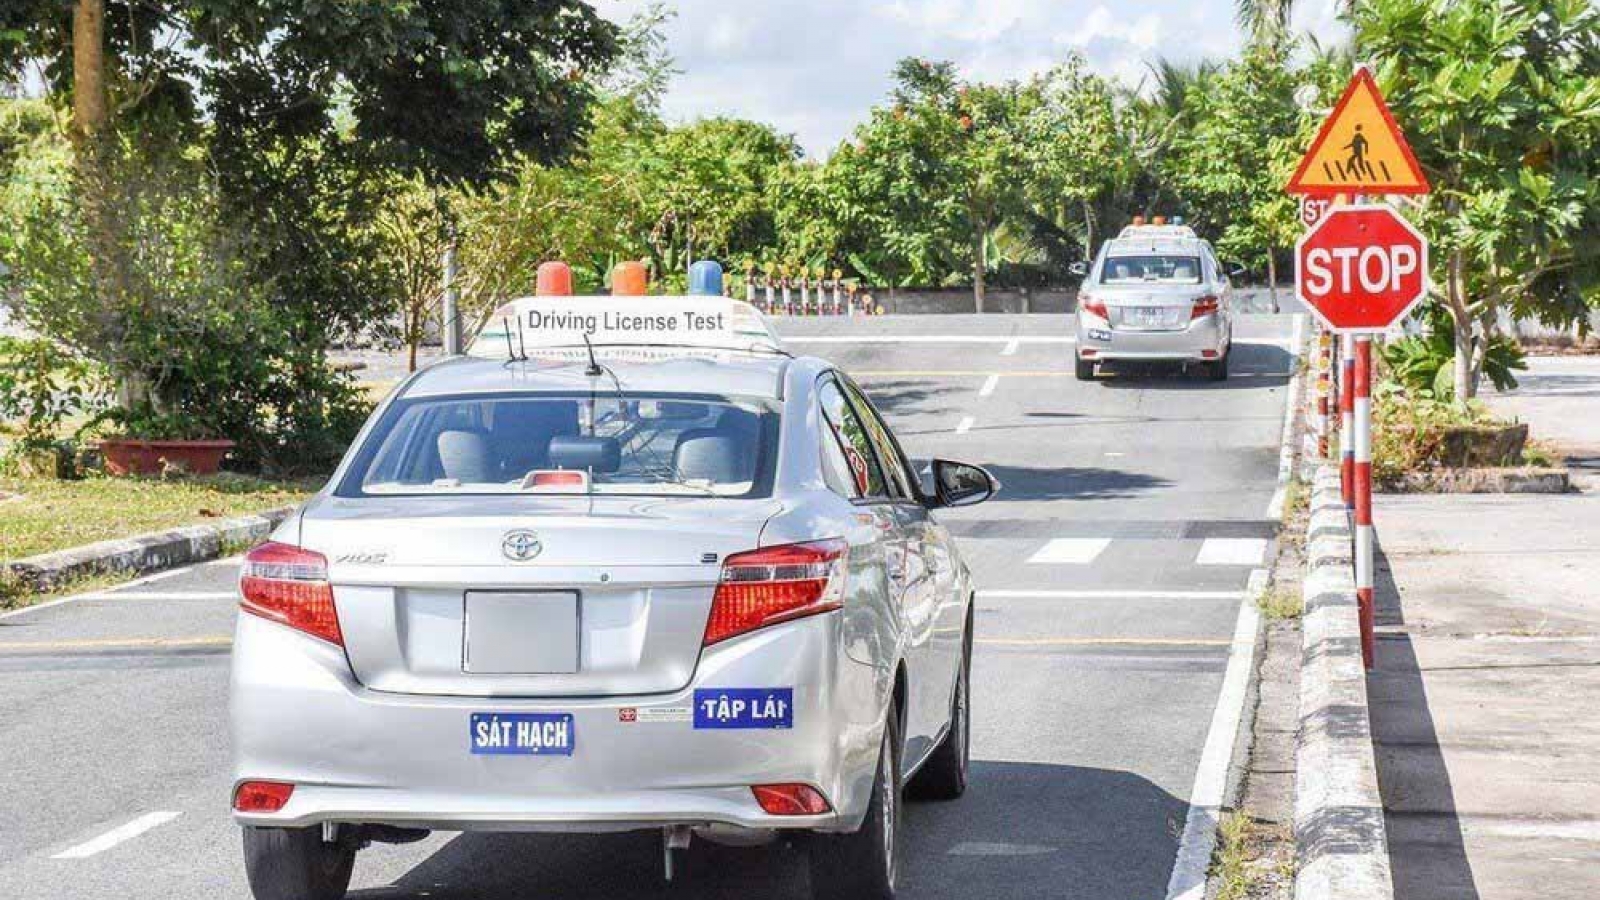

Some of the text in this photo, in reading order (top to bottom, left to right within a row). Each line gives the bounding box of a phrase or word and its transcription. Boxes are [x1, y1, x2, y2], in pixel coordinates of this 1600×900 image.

[1304, 200, 1330, 222] ST
[1306, 245, 1417, 296] STOP
[528, 310, 724, 334] Driving License Test
[703, 694, 745, 723] TẬP
[476, 715, 568, 752] SÁT HẠCH
